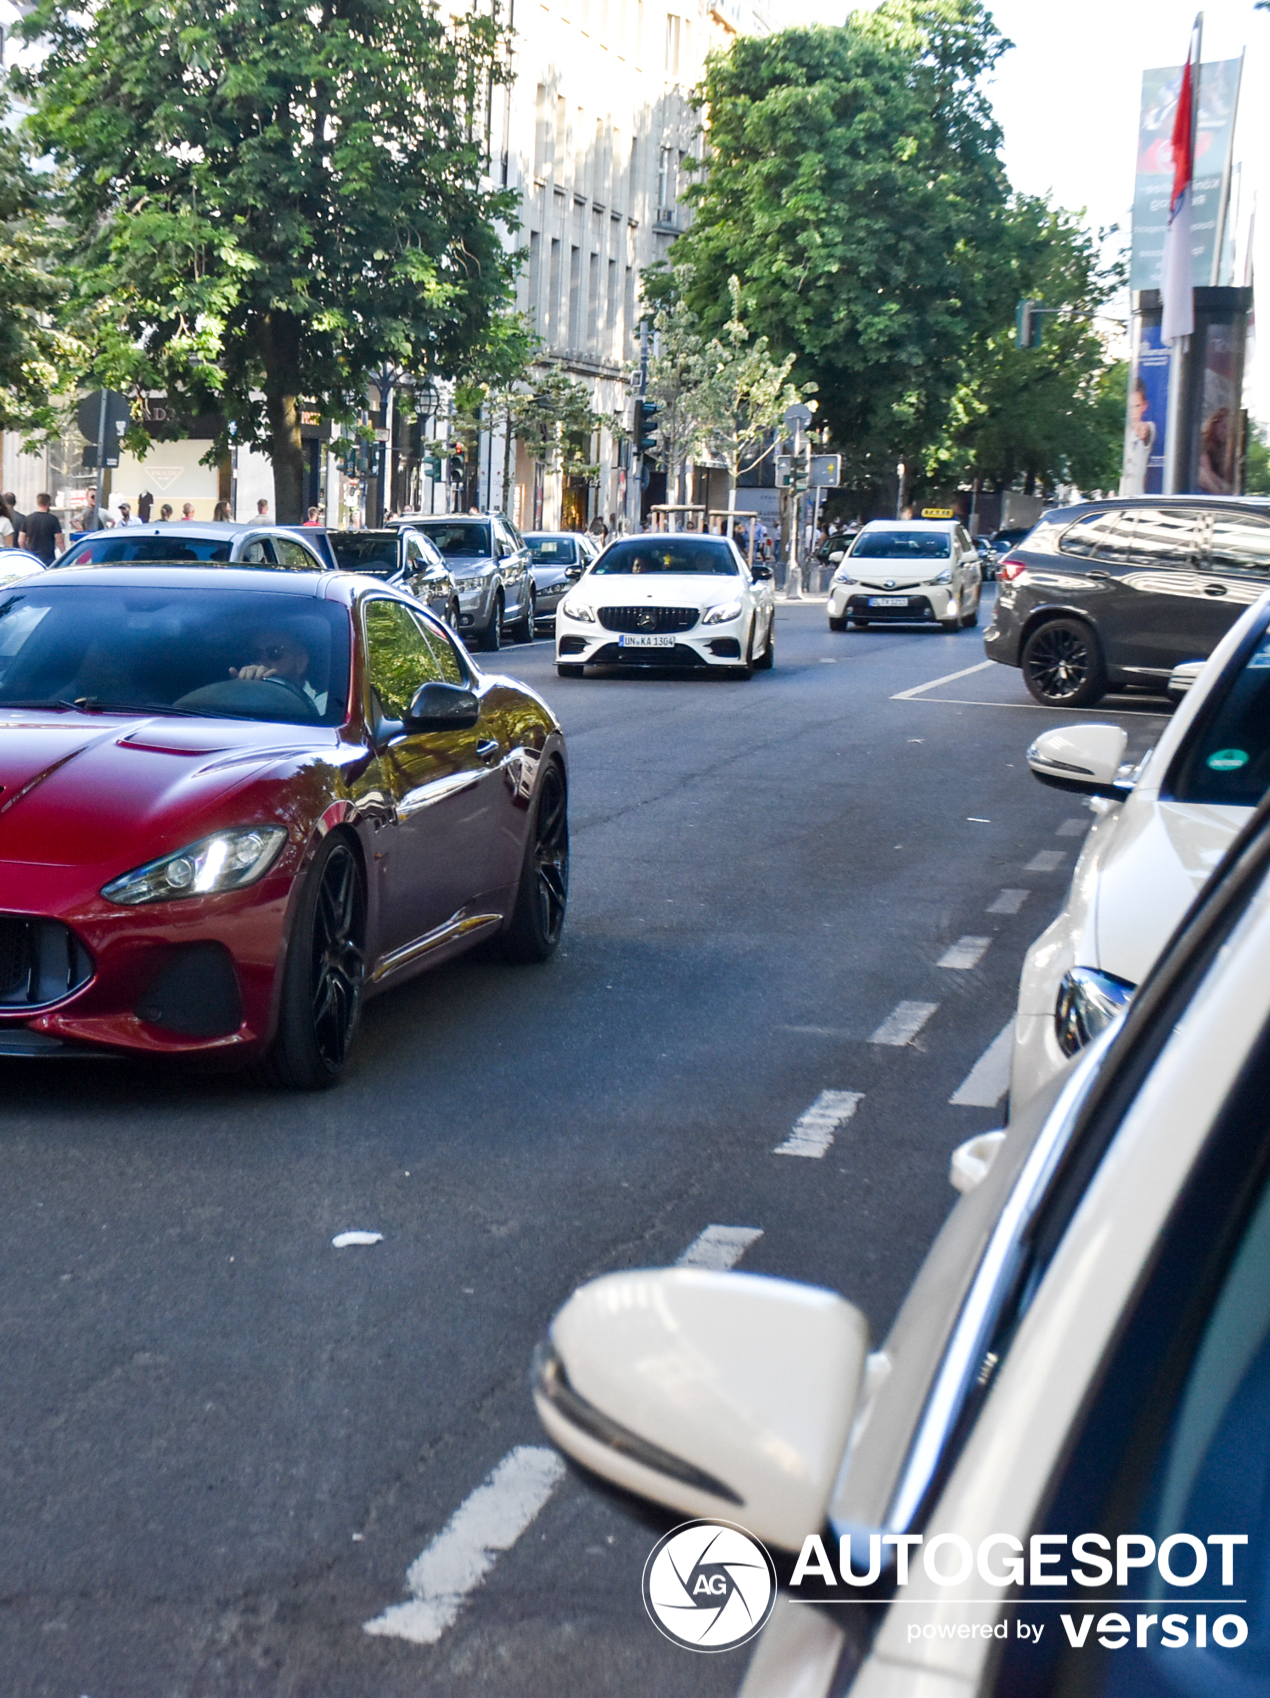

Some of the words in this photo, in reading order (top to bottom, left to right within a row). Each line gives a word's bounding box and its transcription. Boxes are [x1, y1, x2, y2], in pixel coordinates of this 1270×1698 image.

[625, 637, 635, 645] UN
[641, 637, 651, 645] KA
[653, 637, 673, 646] 1304
